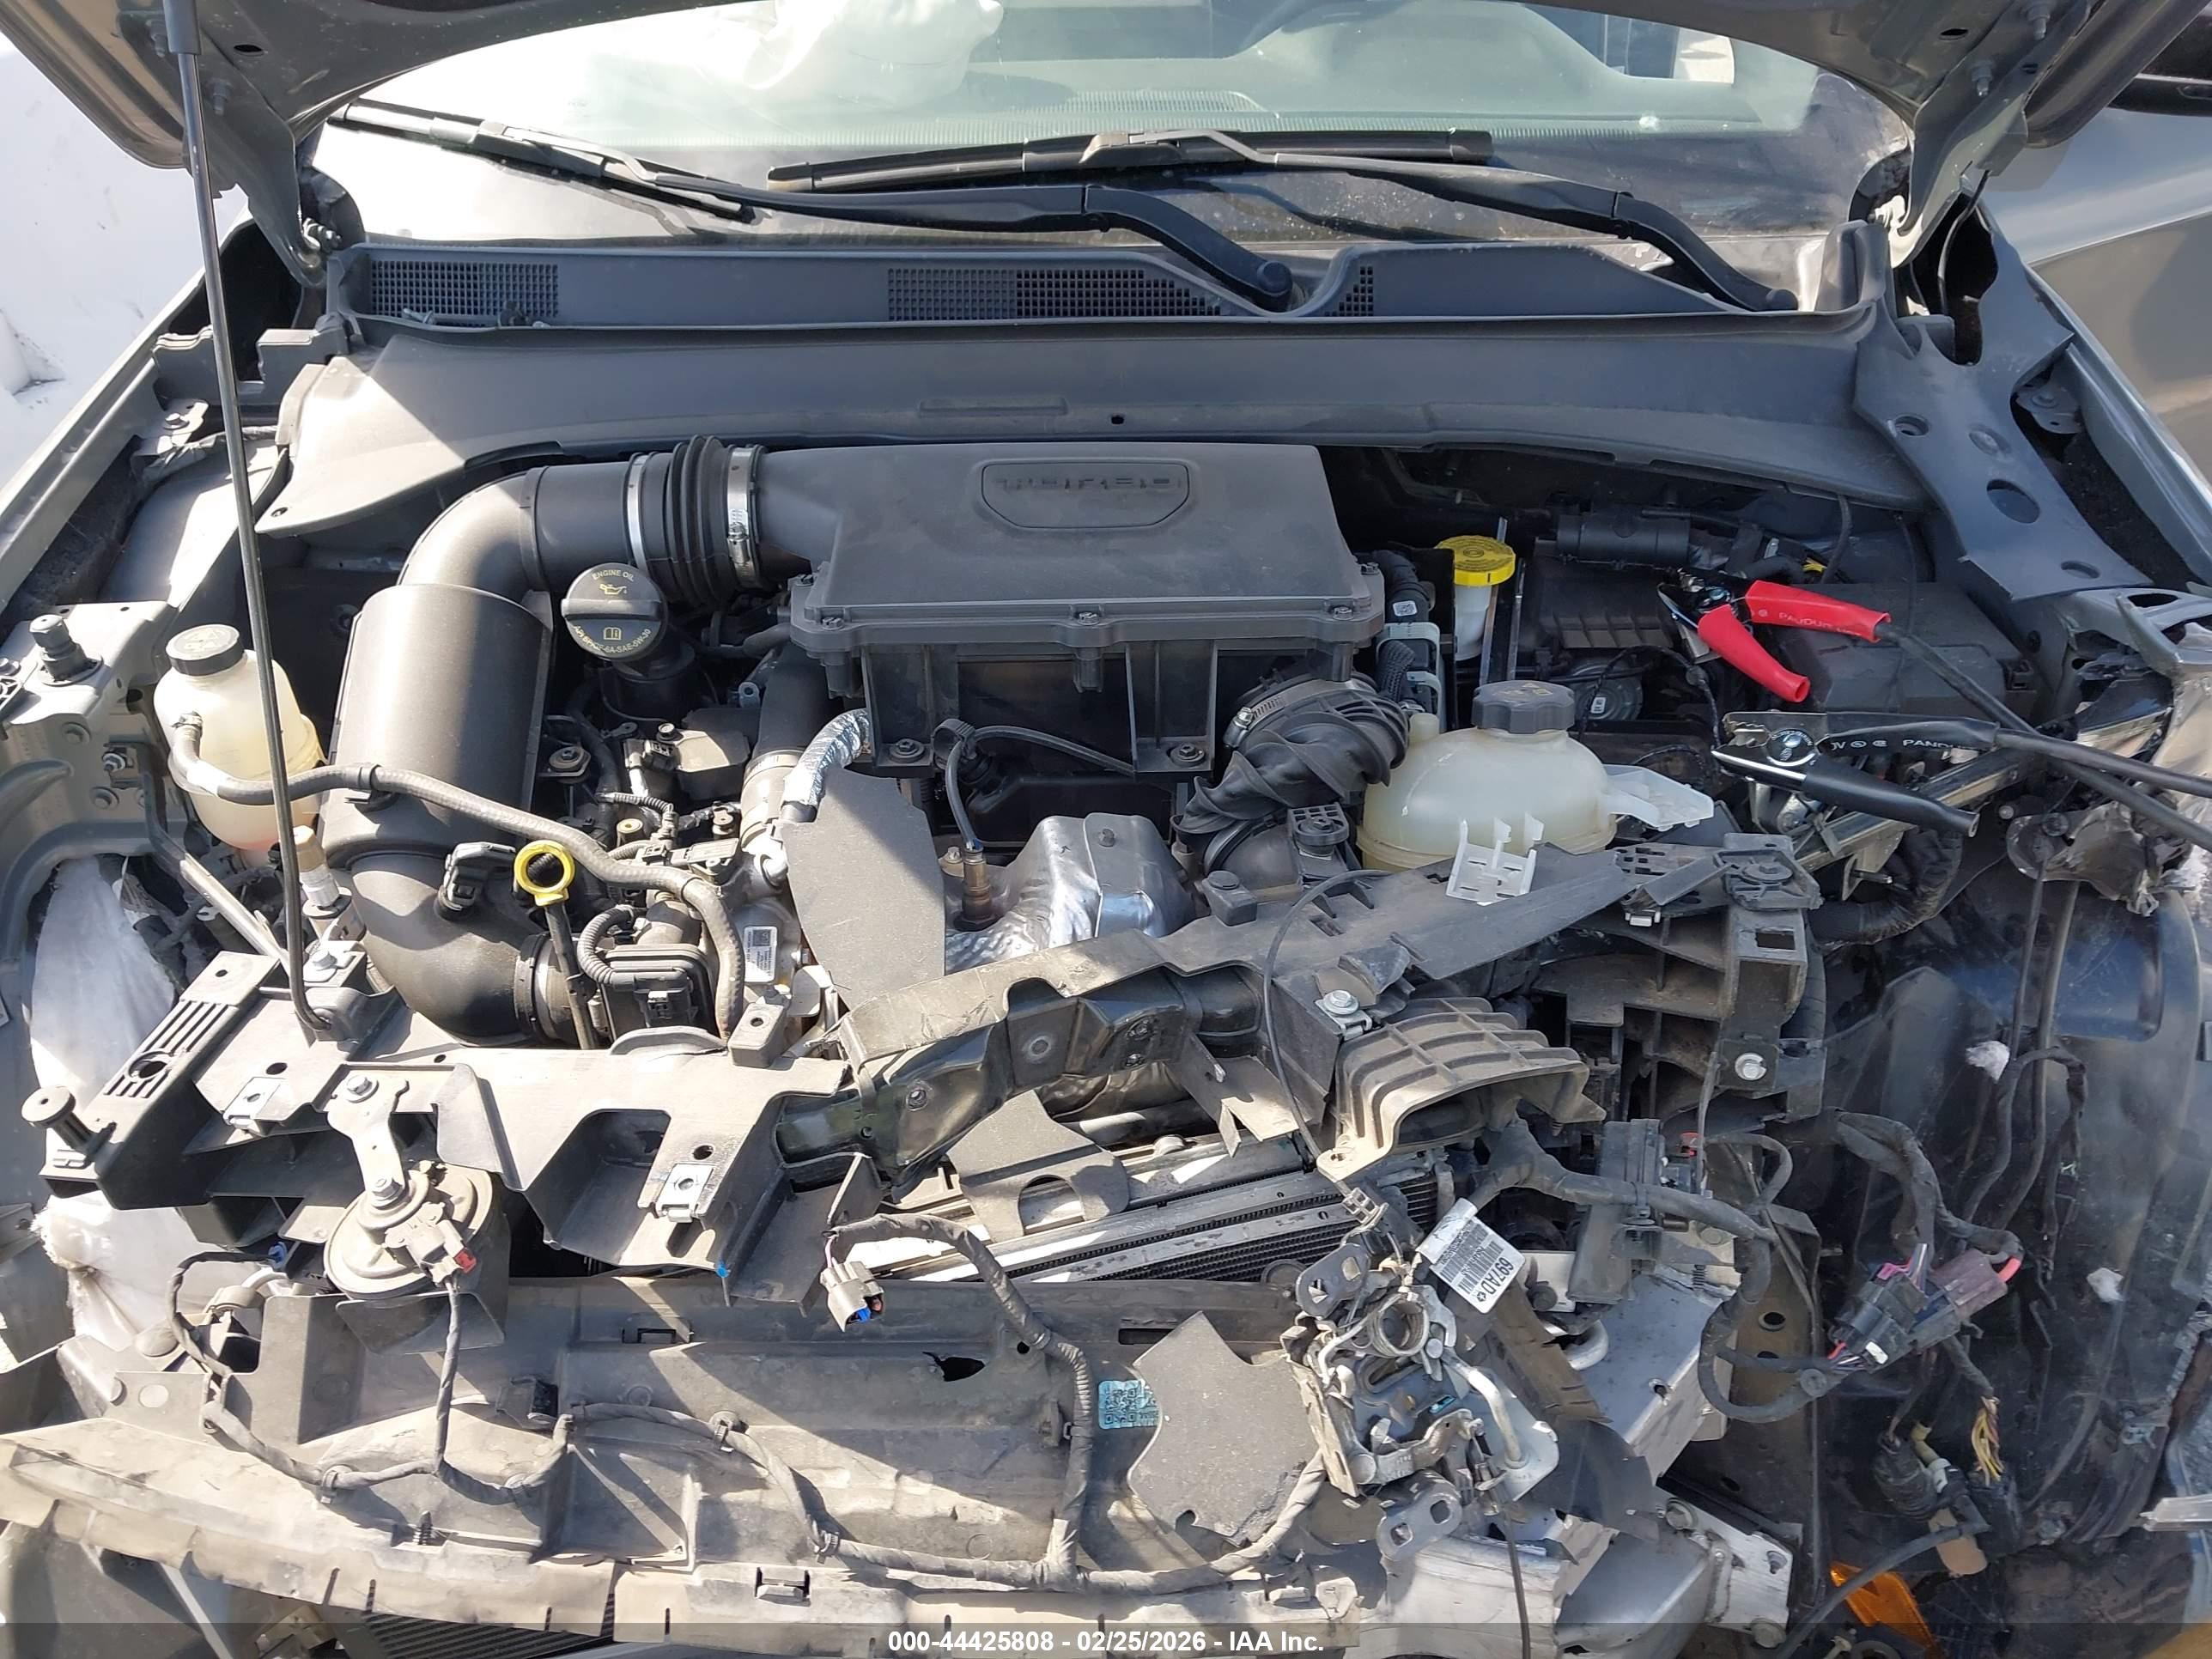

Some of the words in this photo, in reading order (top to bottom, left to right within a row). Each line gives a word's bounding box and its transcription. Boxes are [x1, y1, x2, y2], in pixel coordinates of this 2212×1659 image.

[591, 569, 622, 580] ENGINE
[622, 571, 635, 582] OIL
[1480, 1256, 1514, 1296] 697AD
